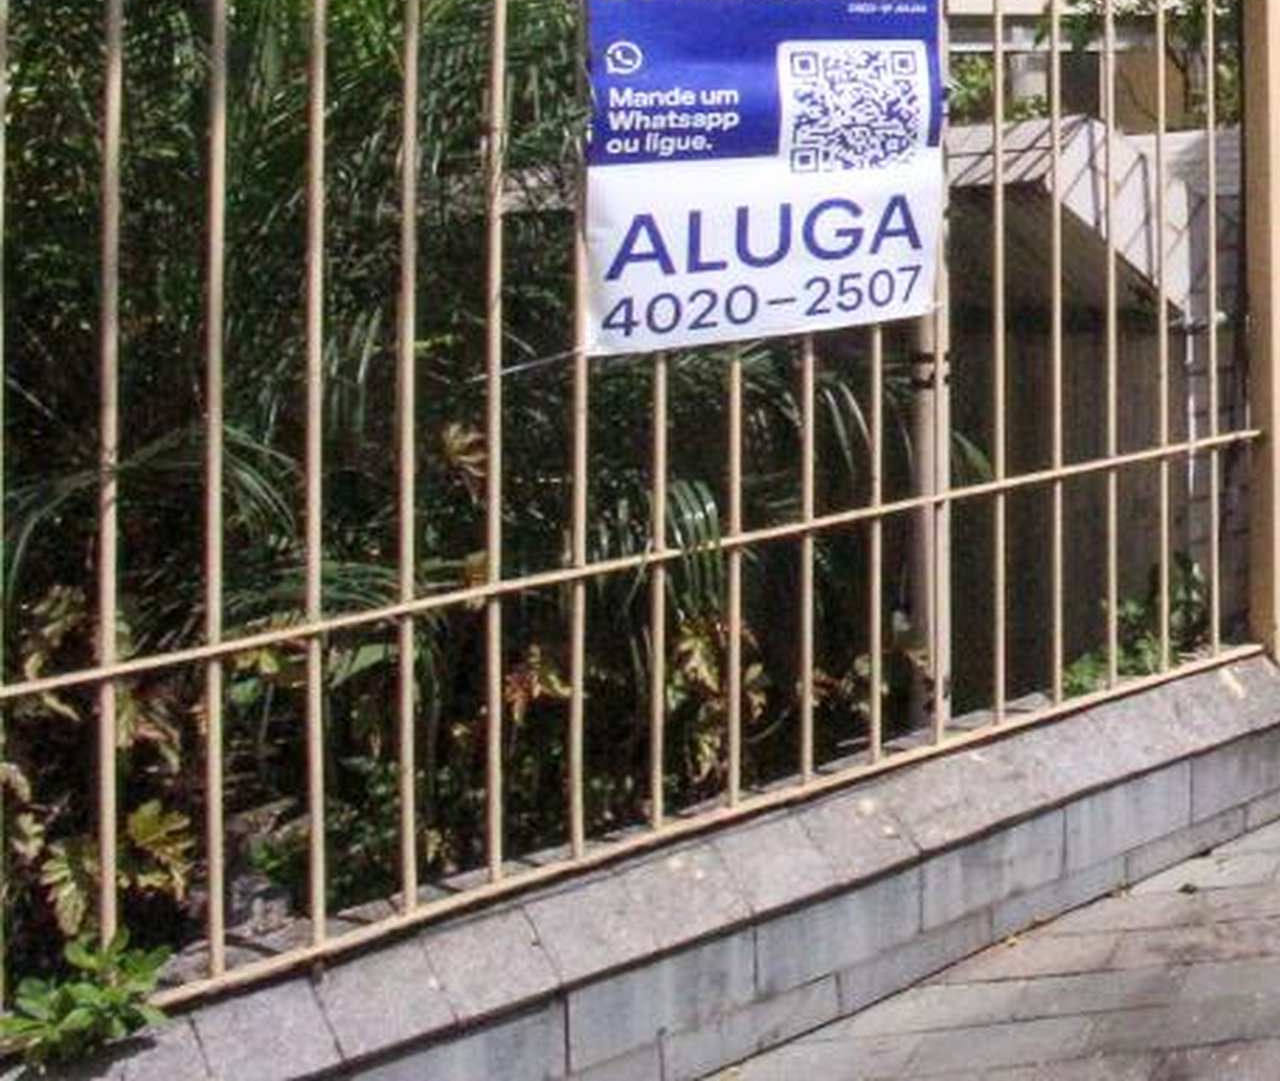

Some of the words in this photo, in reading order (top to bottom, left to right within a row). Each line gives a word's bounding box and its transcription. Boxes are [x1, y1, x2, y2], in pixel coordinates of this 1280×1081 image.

[608, 87, 695, 108] Mande
[700, 89, 740, 107] um
[608, 110, 740, 133] Whatsapp
[606, 137, 640, 155] ou
[645, 132, 713, 157] ligue.
[604, 193, 923, 282] ALUGA
[601, 264, 923, 338] 4020-2507
